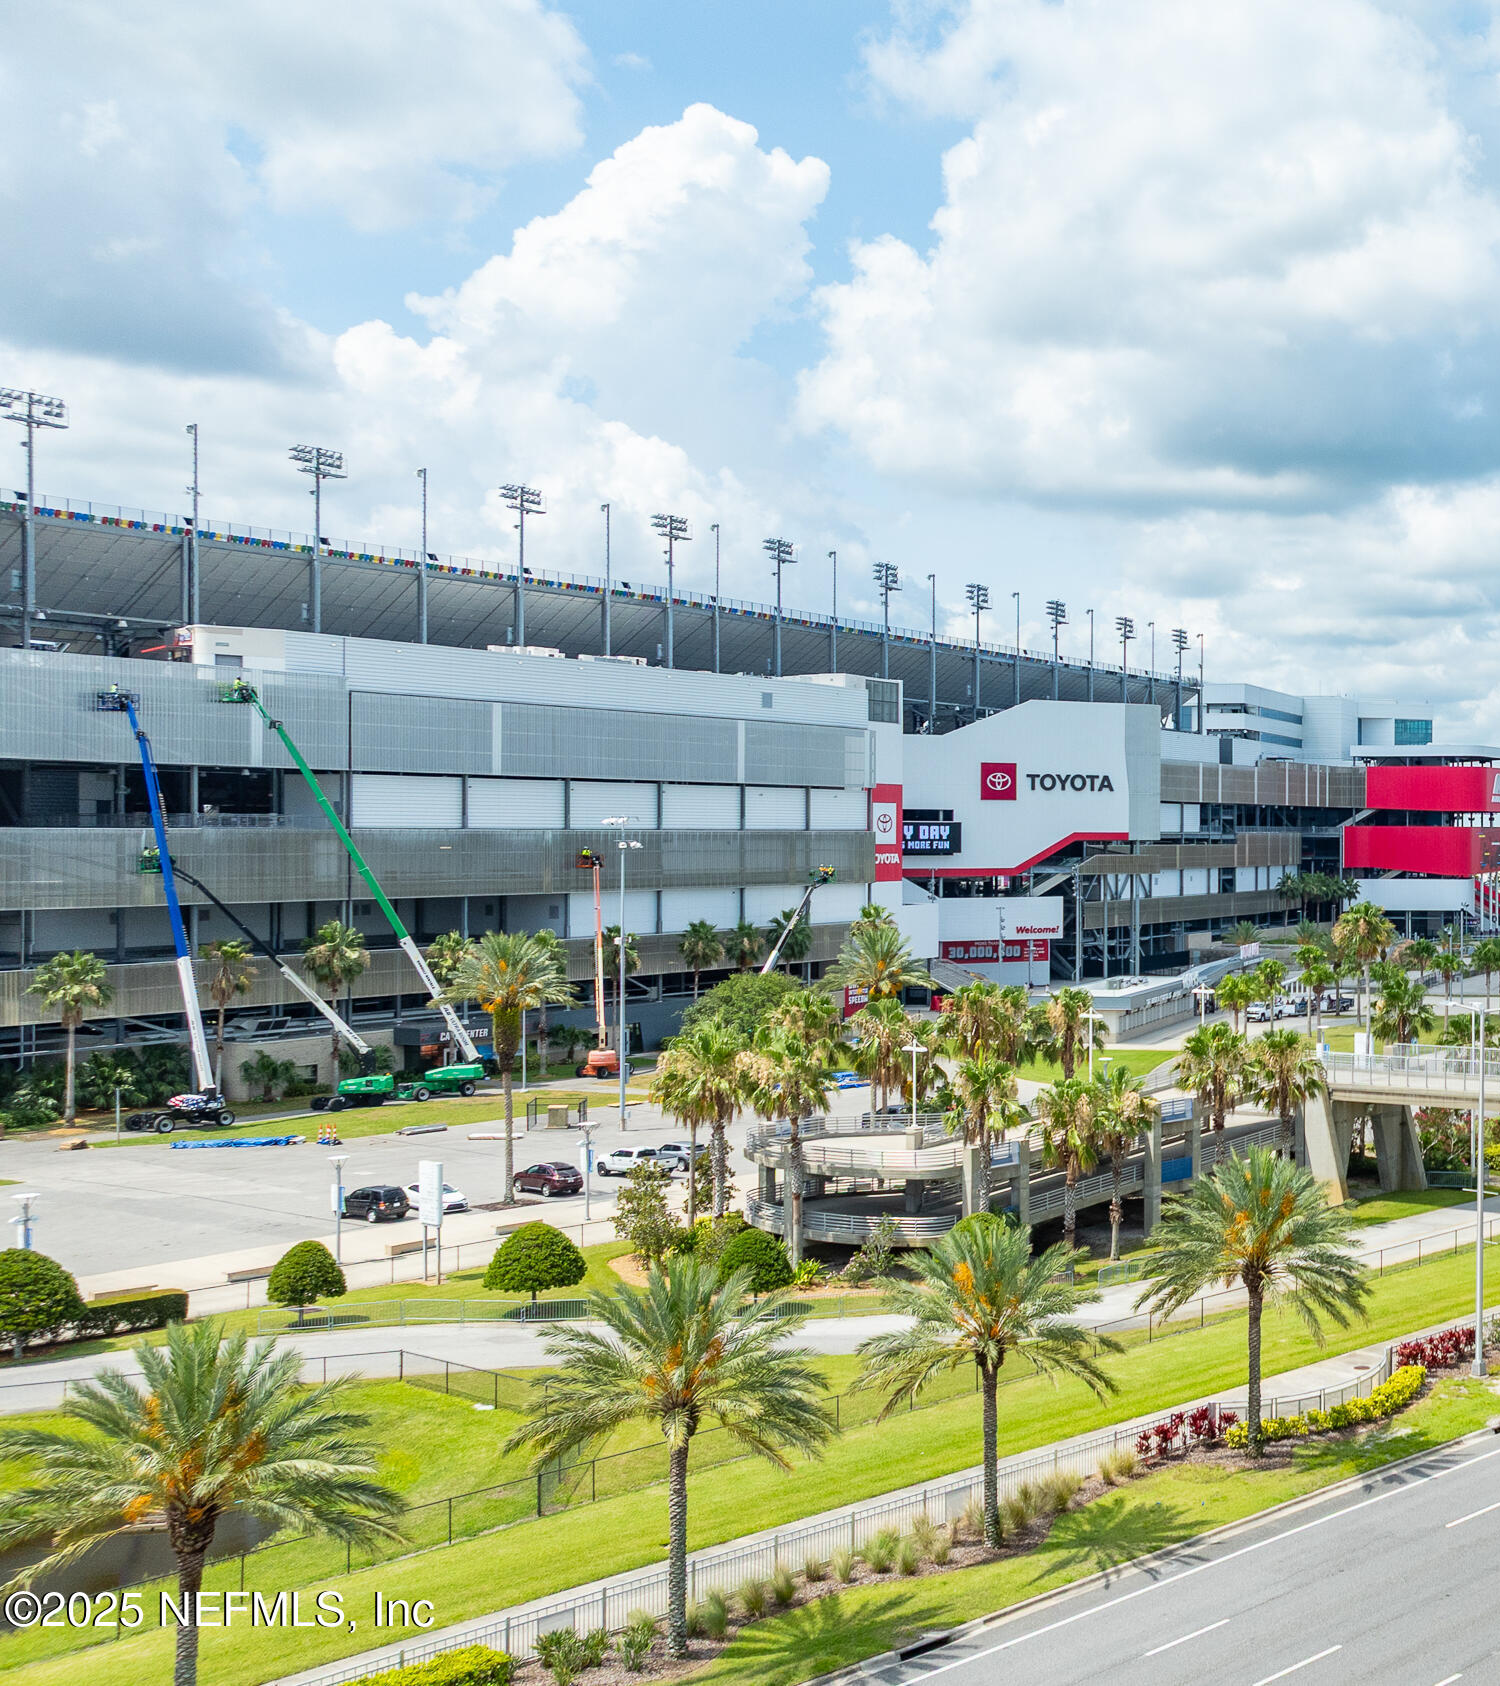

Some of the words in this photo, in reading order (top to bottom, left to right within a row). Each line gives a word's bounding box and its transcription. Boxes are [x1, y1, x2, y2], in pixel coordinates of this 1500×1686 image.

[1026, 774, 1114, 792] TOYOTA
[919, 825, 950, 840] DAY
[908, 841, 931, 849] MORE
[933, 841, 950, 849] FUN
[875, 853, 900, 864] OYOTA
[1015, 925, 1060, 934] Welcome!
[948, 945, 1021, 959] 30,000,00
[466, 1029, 488, 1038] ENTER
